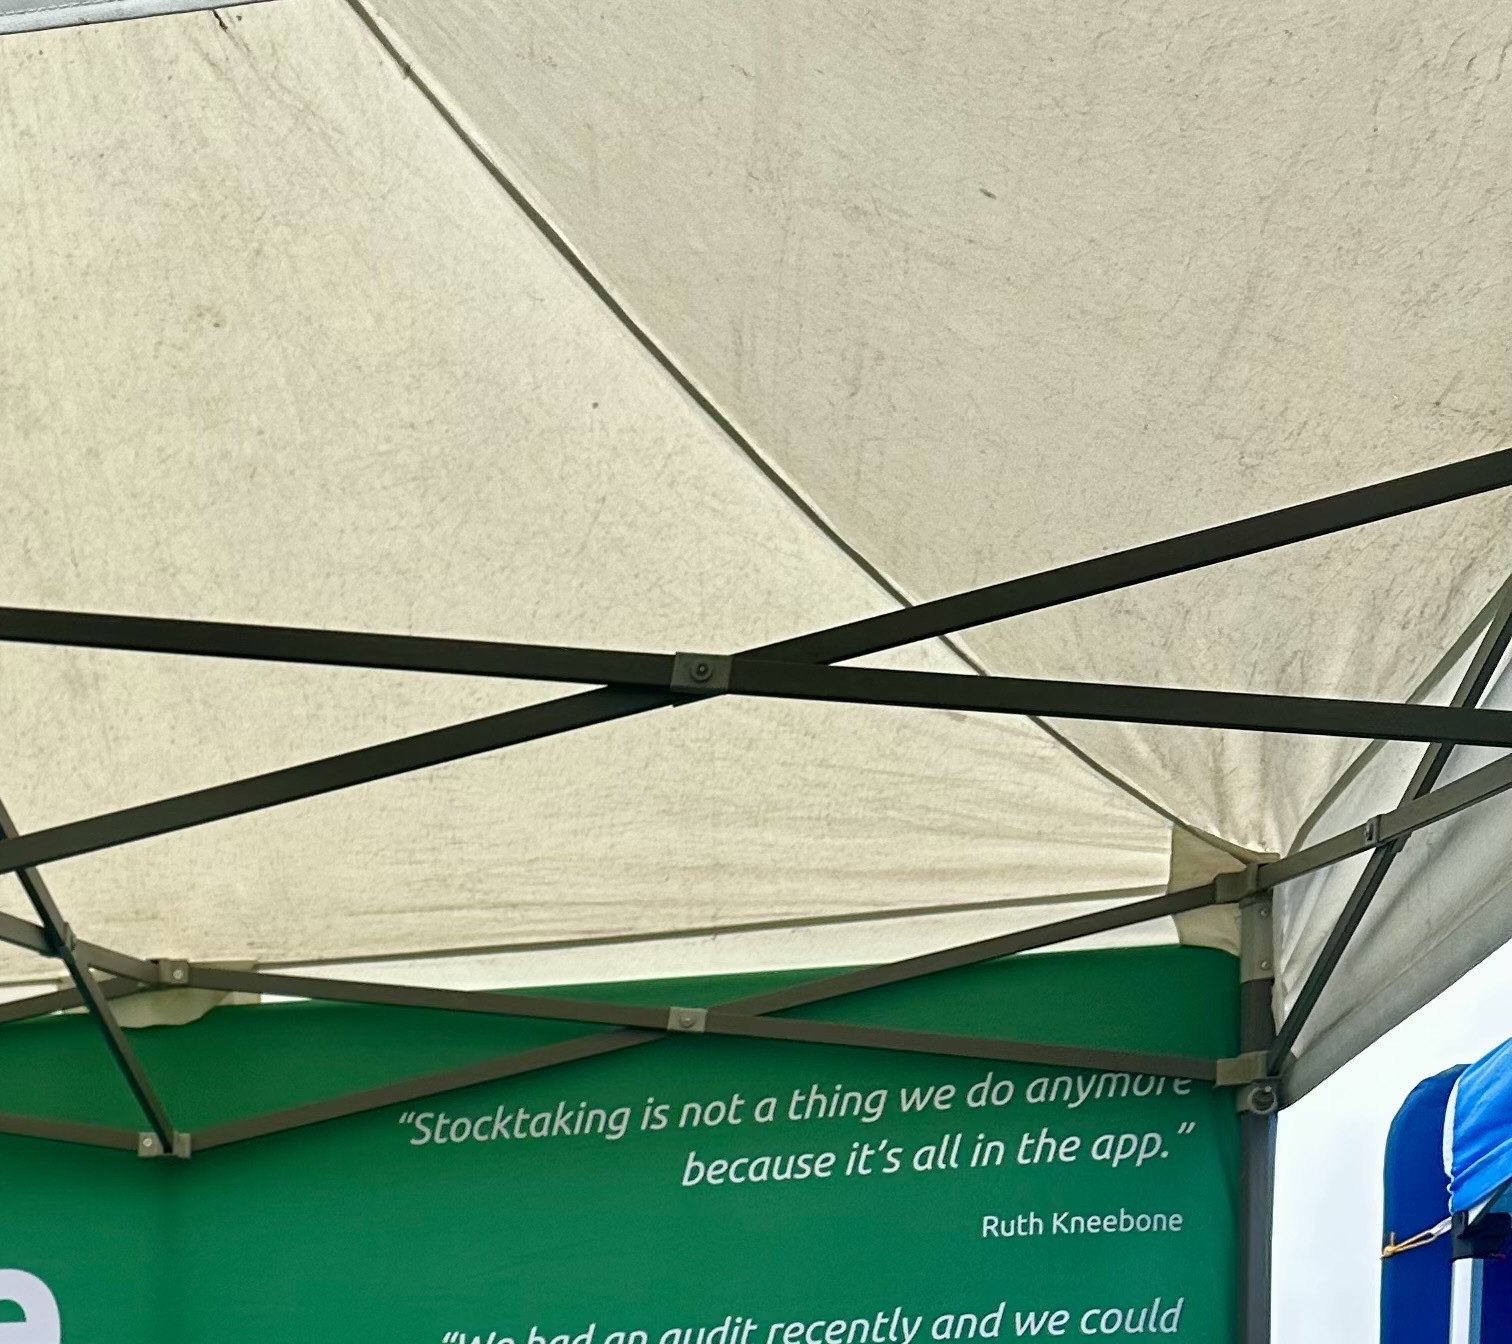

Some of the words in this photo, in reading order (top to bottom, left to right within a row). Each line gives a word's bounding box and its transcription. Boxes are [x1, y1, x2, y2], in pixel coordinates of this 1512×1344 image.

[398, 1102, 632, 1146] “Stocktaking
[640, 1096, 671, 1131] is
[678, 1093, 745, 1128] not
[753, 1097, 778, 1123] a
[788, 1083, 888, 1123] thing
[900, 1084, 956, 1113] we
[966, 1071, 1015, 1108] do
[681, 1151, 836, 1187] because
[912, 1133, 963, 1172] all
[970, 1133, 1005, 1168] in
[1016, 1127, 1081, 1165] the
[982, 1211, 1044, 1238] Ruth
[1052, 1207, 1183, 1235] Kneebone
[931, 1301, 1006, 1340] and
[1015, 1309, 1070, 1337] we
[1080, 1297, 1184, 1335] could
